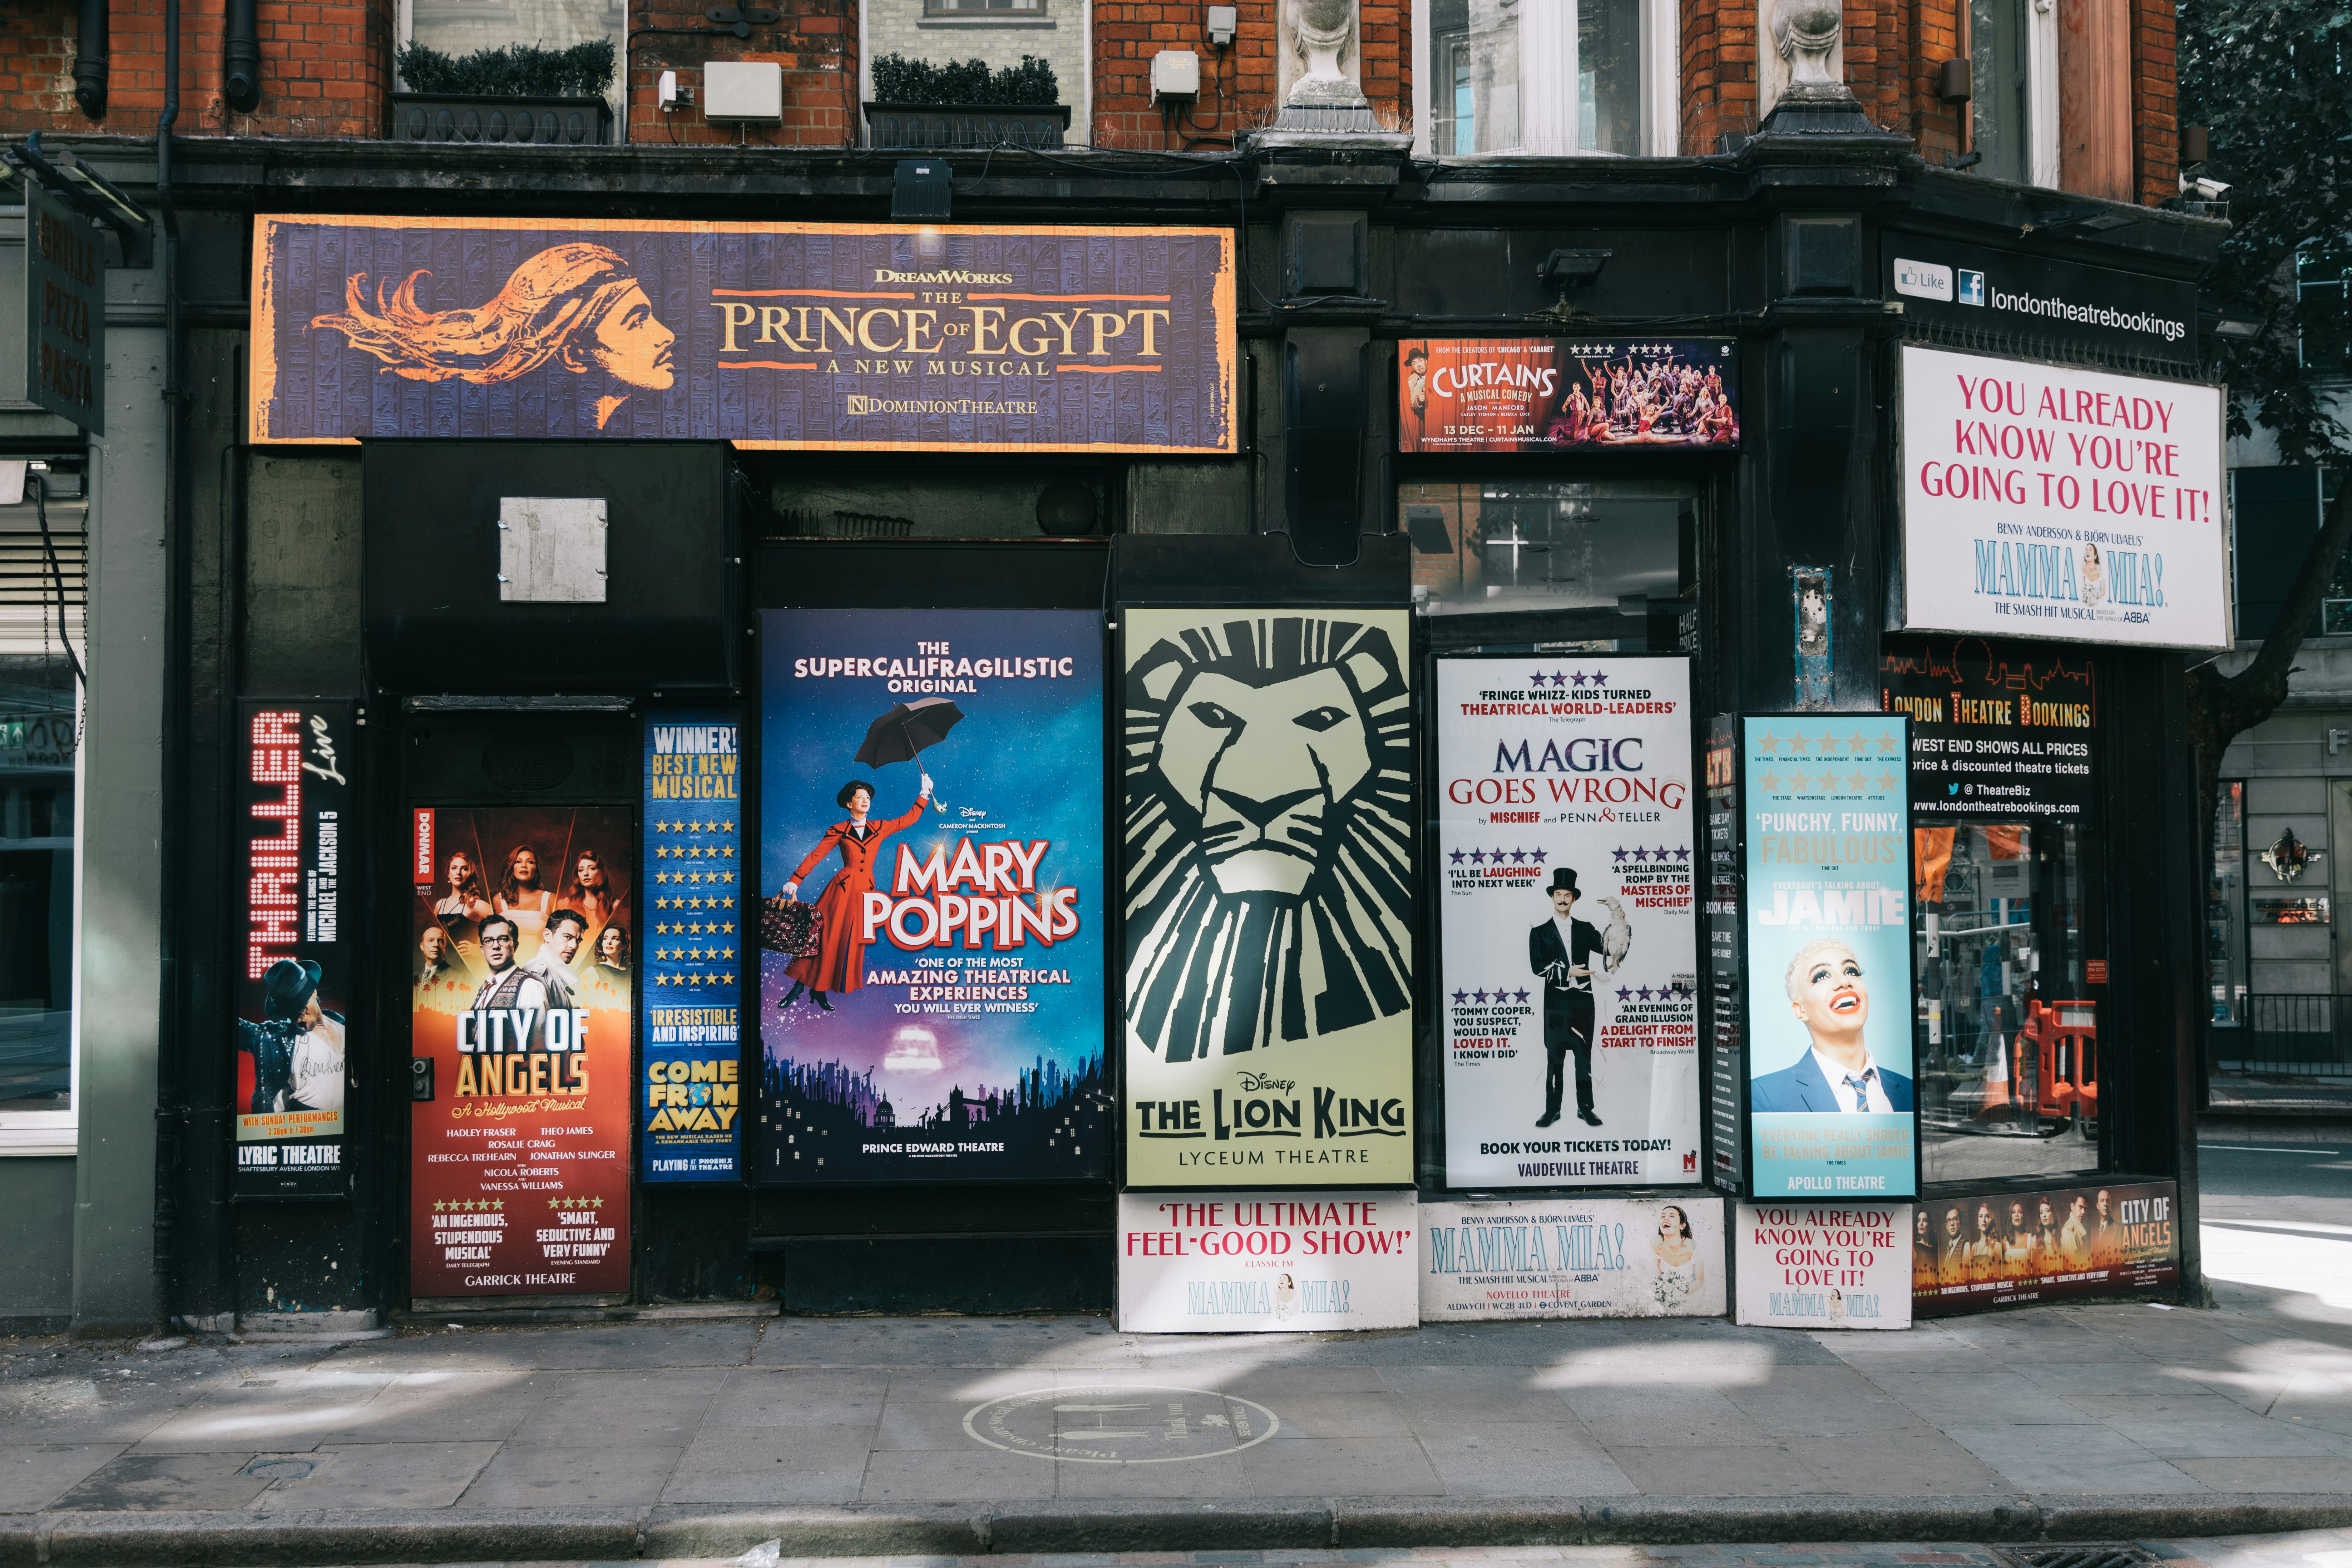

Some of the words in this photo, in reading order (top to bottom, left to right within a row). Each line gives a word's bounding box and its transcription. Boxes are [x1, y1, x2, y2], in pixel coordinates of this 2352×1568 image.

[40, 211, 95, 287] GRILLS
[923, 292, 962, 303] THE
[1921, 273, 1944, 290] Like
[1992, 287, 2185, 341] londontheatrebookings
[45, 278, 90, 347] PIZZA
[711, 303, 944, 352] PRINCE
[944, 323, 970, 336] OF
[959, 307, 1170, 355] EGYPT
[41, 341, 92, 410] PASTA
[826, 360, 841, 373] A
[855, 360, 913, 374] NEW
[928, 361, 1049, 375] MUSICAL
[1433, 363, 1556, 397] CURTAINS
[1460, 393, 1465, 403] A
[1467, 389, 1499, 401] MUSICAL
[1502, 390, 1532, 402] COMEDY
[1957, 375, 2025, 415] YOU
[2039, 386, 2173, 433] ALREADY
[1444, 426, 1456, 435] 13
[1459, 425, 1483, 435] DEC
[1497, 425, 1506, 434] 11
[1510, 425, 1533, 434] JAN
[1956, 420, 2055, 463] KNOW
[2067, 433, 2179, 477] YOU'RE
[1921, 461, 2026, 504] GOING
[2037, 473, 2080, 509] TO
[2093, 479, 2165, 518] LOVE
[2176, 488, 2209, 523] IT!
[1997, 523, 2023, 535] BENNY
[2026, 525, 2073, 540] ANDERSSON
[2075, 529, 2082, 540] &
[2085, 529, 2109, 543] BJÖRN
[2111, 533, 2143, 546] ULVAEUS'
[1975, 539, 2078, 601] MAMMA
[2106, 551, 2163, 607] MIA!
[918, 642, 949, 655] THE
[795, 657, 1072, 678] SUPERCALIFRAGILISTIC
[888, 679, 977, 693] ORIGINAL
[1603, 690, 1651, 699] TURNED
[1461, 703, 1549, 715] THEATRICAL
[1951, 692, 2012, 725] THEATRE
[2021, 695, 2090, 728] BOOKINGS
[654, 727, 736, 753] WINNER!
[1913, 739, 1945, 751] WEST
[1948, 741, 1973, 752] END
[1976, 741, 2019, 754] SHOWS
[2022, 742, 2044, 755] ALL
[2047, 743, 2088, 756] PRICES
[653, 755, 694, 775] BEST
[699, 754, 737, 775] NEW
[1493, 738, 1643, 773] MAGIC
[653, 776, 737, 798] MUSICAL
[1449, 778, 1536, 805] GOES
[1546, 777, 1686, 810] WRONG
[1977, 785, 2030, 796] TheatreBiz
[1842, 813, 1902, 833] FUNNY,
[250, 712, 300, 978] THRILLER
[302, 714, 345, 785] Live
[419, 813, 430, 874] DONMAR
[896, 841, 1046, 892] MARY
[863, 888, 1077, 945] POPPINS
[1706, 901, 1721, 914] BOOK
[1722, 901, 1735, 914] HERE
[1758, 890, 1904, 925] JAMIE
[457, 1009, 534, 1052] CITY
[547, 1008, 589, 1051] OF
[455, 1053, 589, 1097] ANGELS
[649, 1060, 738, 1083] COME
[243, 1117, 259, 1127] WITH
[261, 1115, 286, 1126] SUNDAY
[289, 1111, 338, 1124] PERFORMANCES
[647, 1107, 738, 1131] AWAY
[1136, 1100, 1201, 1130] THE
[1213, 1089, 1301, 1141] LION
[1313, 1087, 1406, 1139] KING
[447, 1129, 481, 1137] HADLEY
[484, 1128, 516, 1137] FRASER
[541, 1127, 563, 1136] THEO
[566, 1127, 593, 1135] JAMES
[239, 1146, 277, 1164] LYRIC
[282, 1146, 340, 1164] THEATRE
[862, 1144, 902, 1153] PRINCE
[906, 1143, 954, 1153] EDWARD
[958, 1143, 1004, 1152] THEATRE
[1180, 1151, 1264, 1166] LYCEUM
[1275, 1150, 1369, 1163] THEATRE
[1480, 1143, 1520, 1155] BOOK
[1523, 1142, 1561, 1154] YOUR
[1564, 1141, 1619, 1153] TICKETS
[1622, 1139, 1671, 1152] TODAY!
[1518, 1162, 1586, 1177] VAUDEVILLE
[1589, 1161, 1639, 1176] THEATRE
[1788, 1177, 1831, 1189] APOLLO
[1835, 1176, 1885, 1189] THEATRE
[1235, 1202, 1377, 1227] ULTIMATE
[2121, 1199, 2149, 1224] CITY
[2154, 1197, 2169, 1221] OF
[1127, 1231, 1291, 1256] FEEL-GOOD
[2122, 1221, 2171, 1248] ANGELS
[465, 1275, 521, 1287] GARRICK
[525, 1273, 576, 1285] THEATRE
[1486, 1290, 1528, 1300] NOVELLO
[1531, 1290, 1571, 1299] THEATRE
[1168, 1404, 1184, 1416] you
[1232, 1406, 1247, 1419] DIALS
[1162, 1417, 1188, 1441] Thank
[1236, 1420, 1252, 1436] SEVEN
